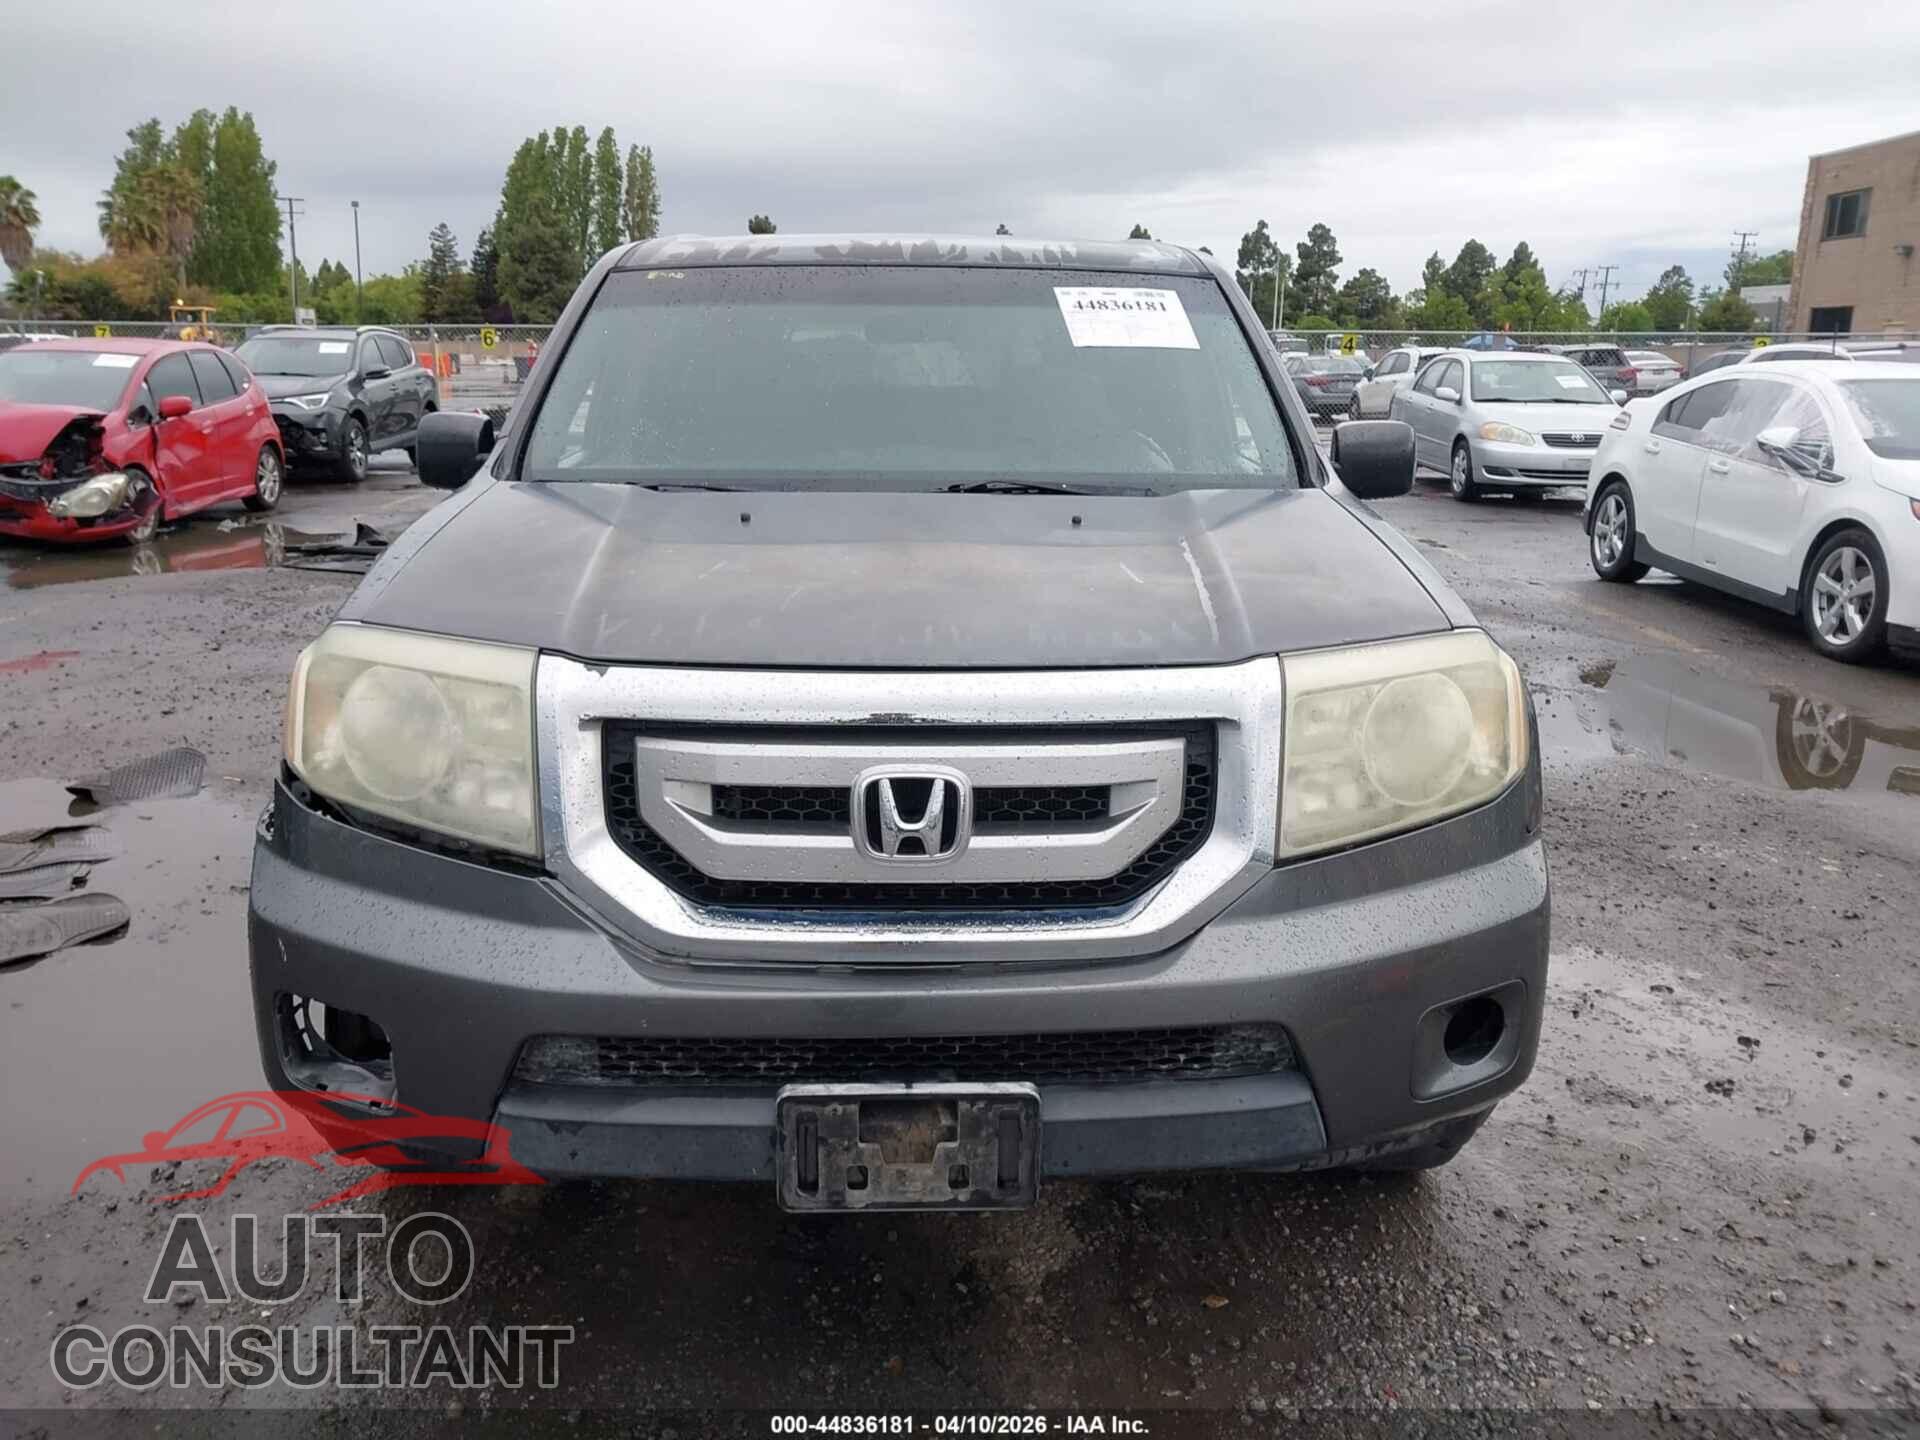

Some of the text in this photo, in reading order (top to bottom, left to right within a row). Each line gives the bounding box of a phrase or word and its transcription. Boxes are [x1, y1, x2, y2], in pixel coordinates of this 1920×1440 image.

[1073, 299, 1168, 312] 44836181
[483, 331, 494, 347] 6
[1343, 336, 1354, 352] 4
